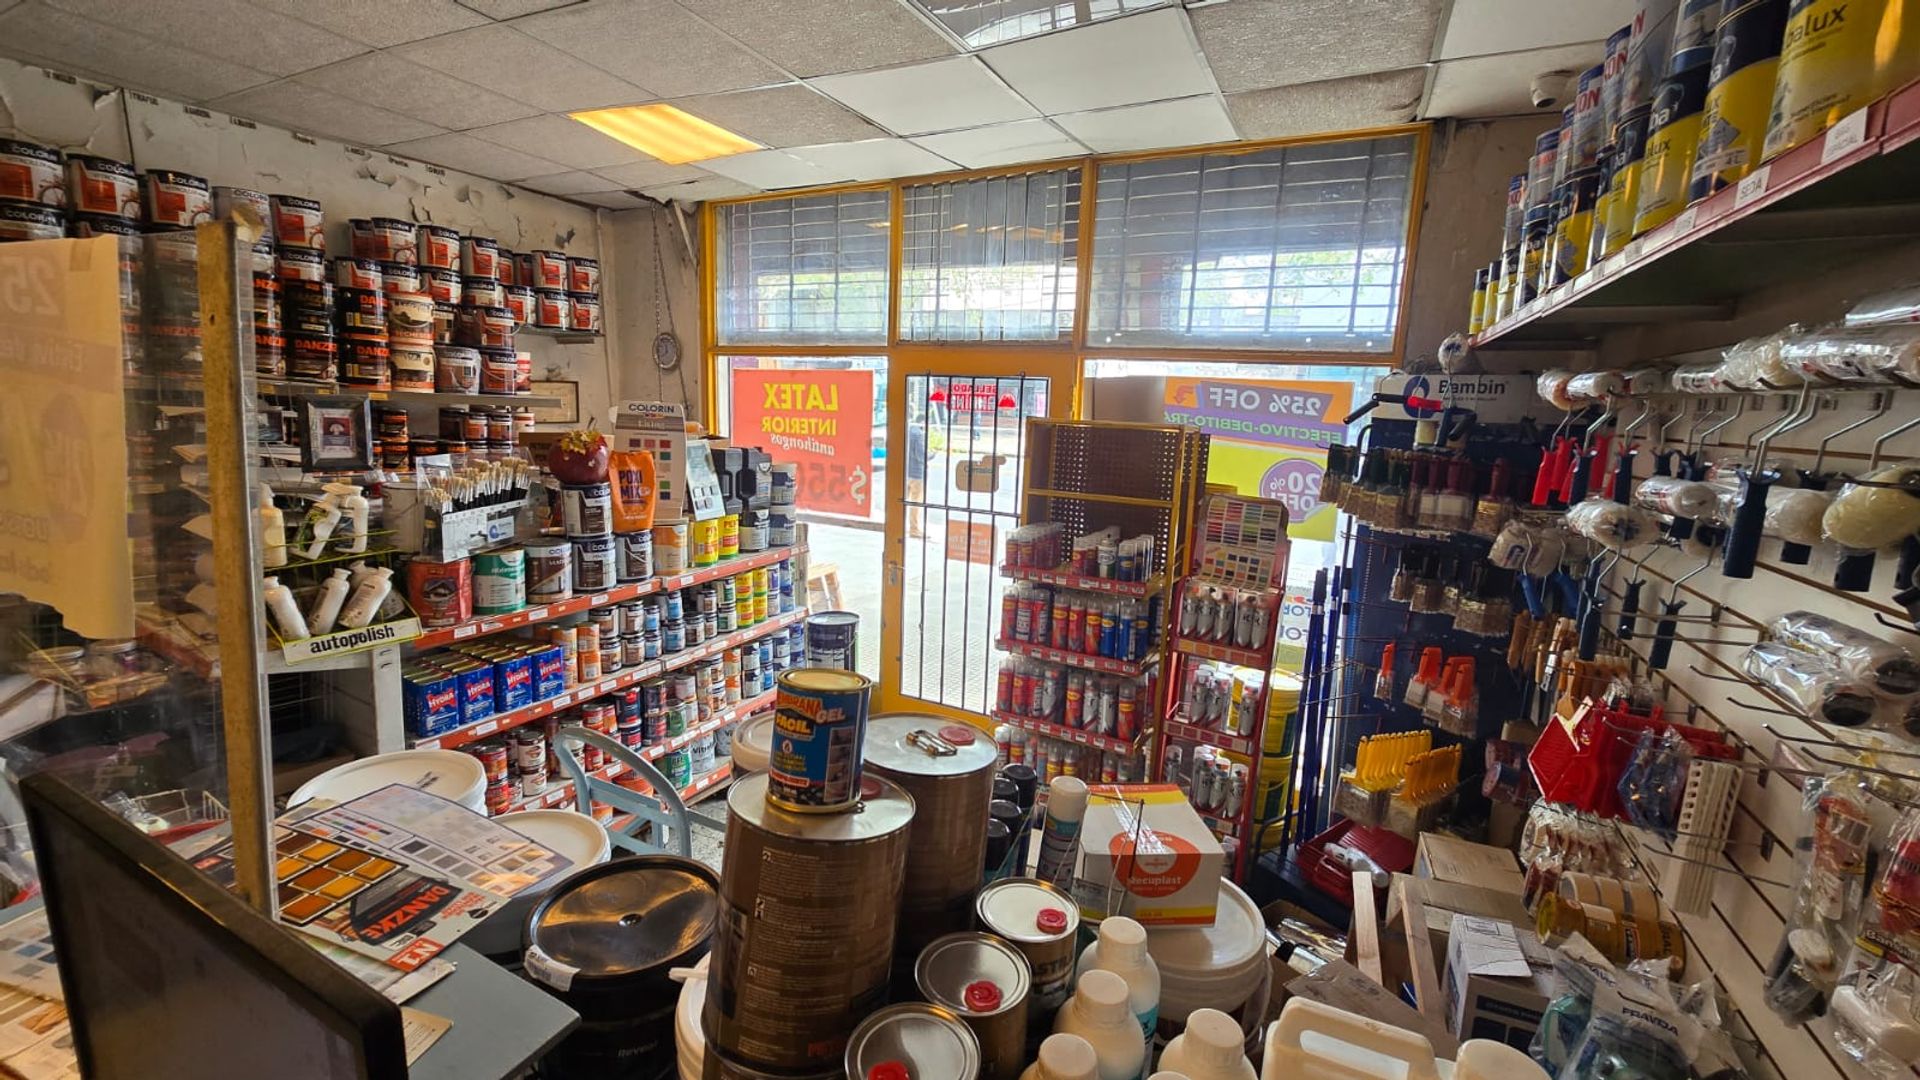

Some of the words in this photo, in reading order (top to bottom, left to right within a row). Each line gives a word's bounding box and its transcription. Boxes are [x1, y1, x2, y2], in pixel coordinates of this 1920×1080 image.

[628, 403, 675, 414] COLORIN
[618, 469, 643, 486] POXI
[620, 484, 640, 499] MIX
[310, 623, 395, 655] autopolish
[817, 706, 846, 724] GEL
[362, 885, 450, 940] DANZKE
